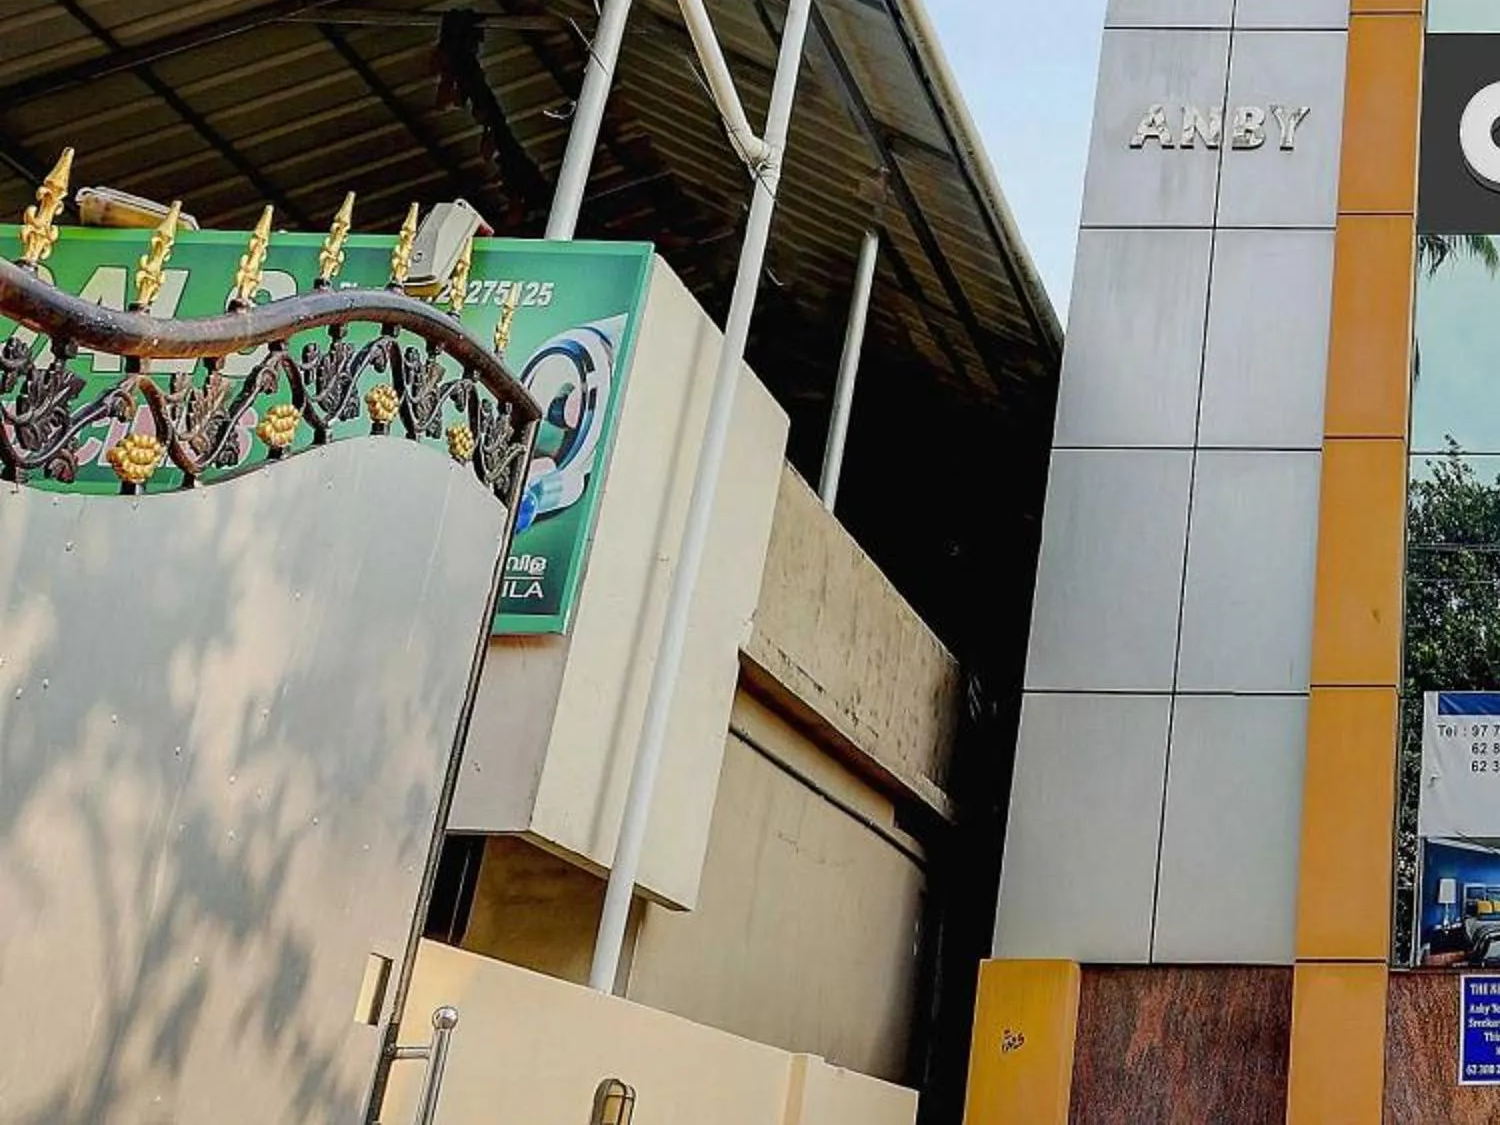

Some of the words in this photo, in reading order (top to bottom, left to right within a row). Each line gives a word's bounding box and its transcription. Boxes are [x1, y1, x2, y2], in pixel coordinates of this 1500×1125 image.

[1129, 104, 1310, 151] ANBY
[1471, 724, 1488, 737] 97
[1471, 742, 1487, 754] 62
[1471, 760, 1487, 772] 62
